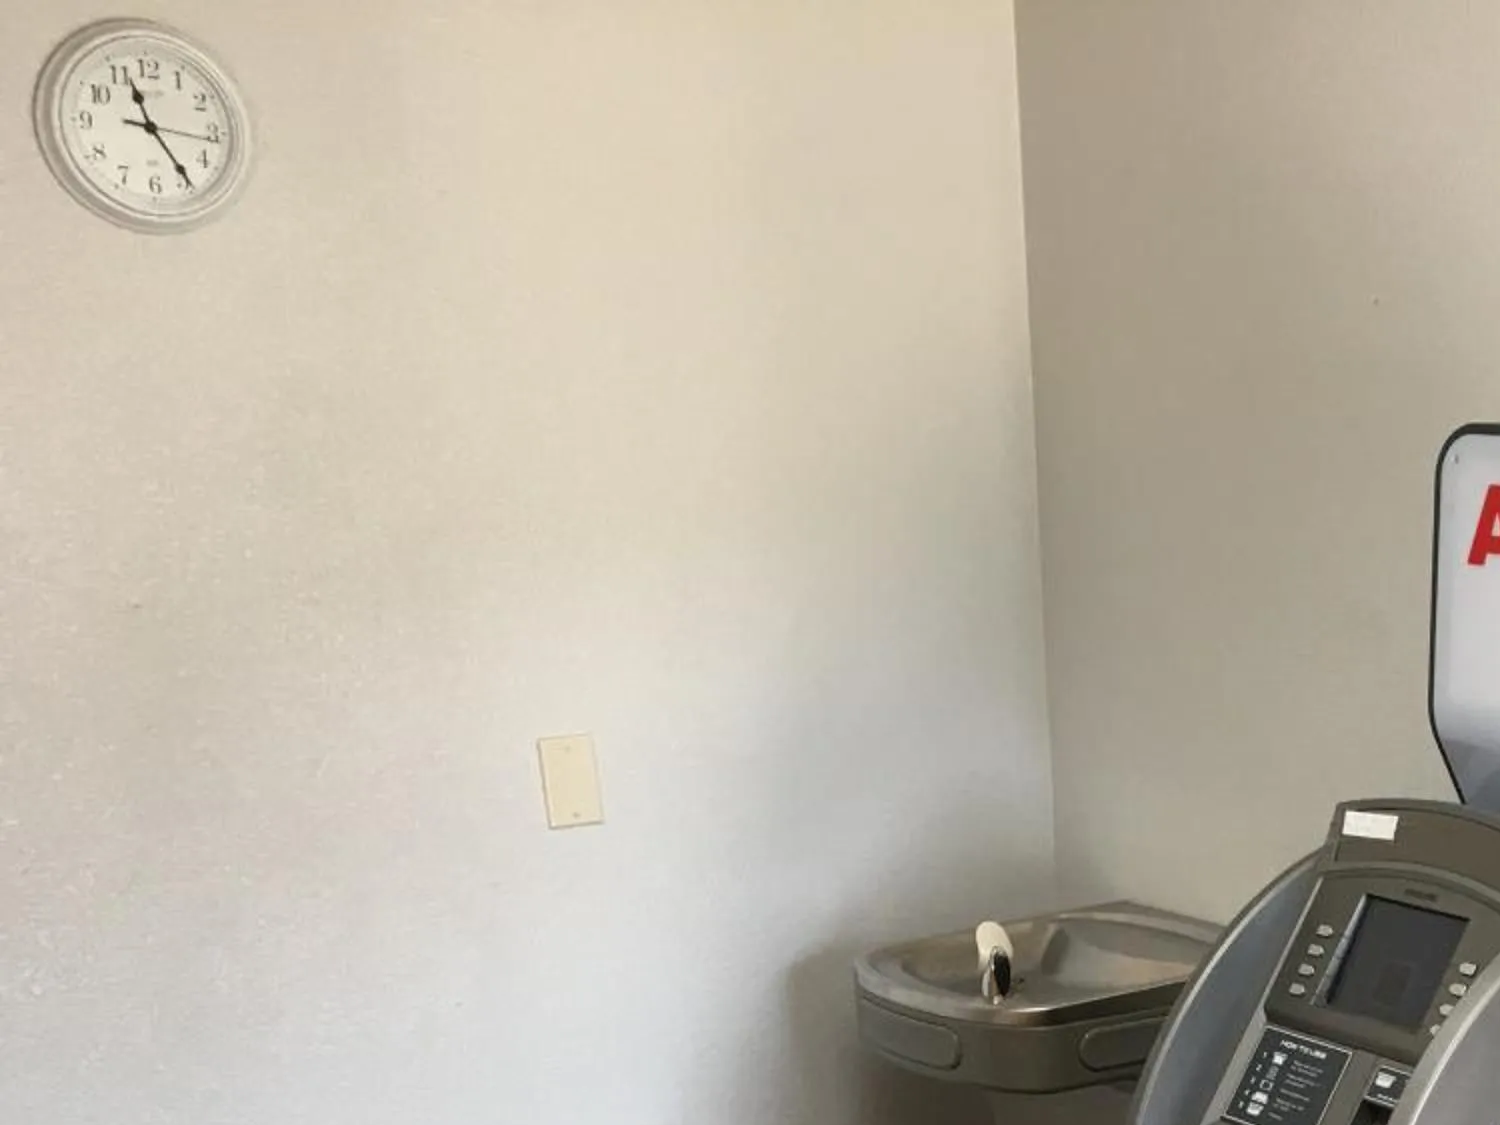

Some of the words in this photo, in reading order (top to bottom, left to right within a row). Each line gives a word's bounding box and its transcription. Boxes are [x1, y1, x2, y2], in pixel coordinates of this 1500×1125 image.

[109, 64, 130, 86] 11
[138, 58, 160, 80] 12
[173, 70, 182, 91] 1
[90, 83, 111, 105] 10
[193, 92, 208, 112] 2
[79, 111, 93, 130] 9
[196, 149, 209, 169] 4
[117, 164, 129, 185] 7
[148, 175, 162, 194] 6
